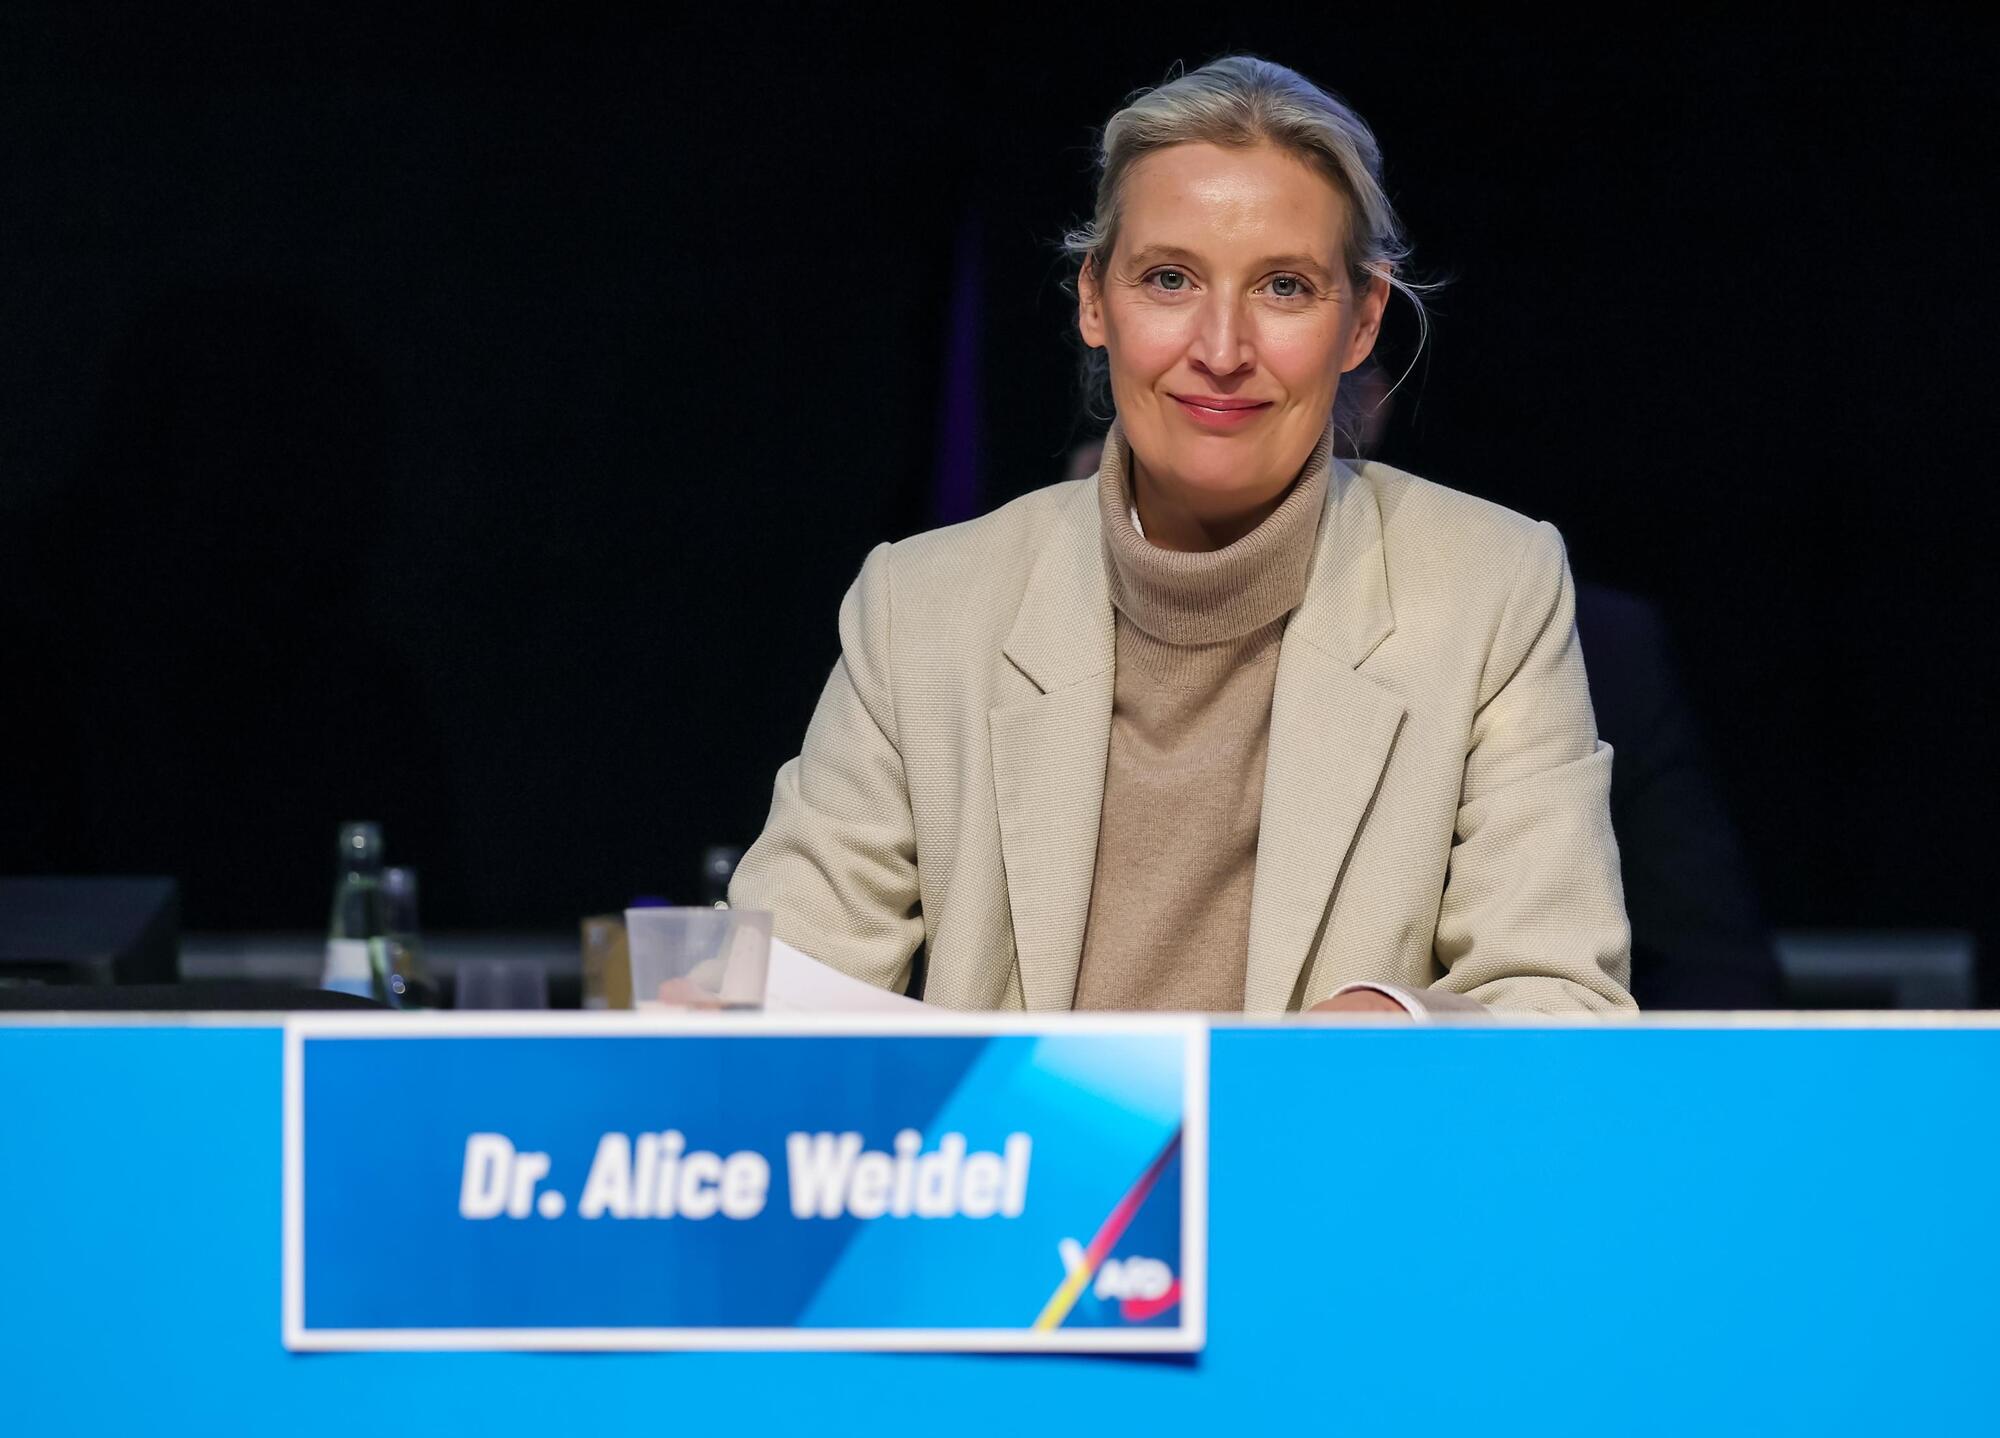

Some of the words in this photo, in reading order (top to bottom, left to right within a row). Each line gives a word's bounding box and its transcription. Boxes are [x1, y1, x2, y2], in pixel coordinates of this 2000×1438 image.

[460, 1133, 566, 1219] Dr.
[580, 1130, 770, 1219] Alice
[787, 1130, 1032, 1219] Weidel
